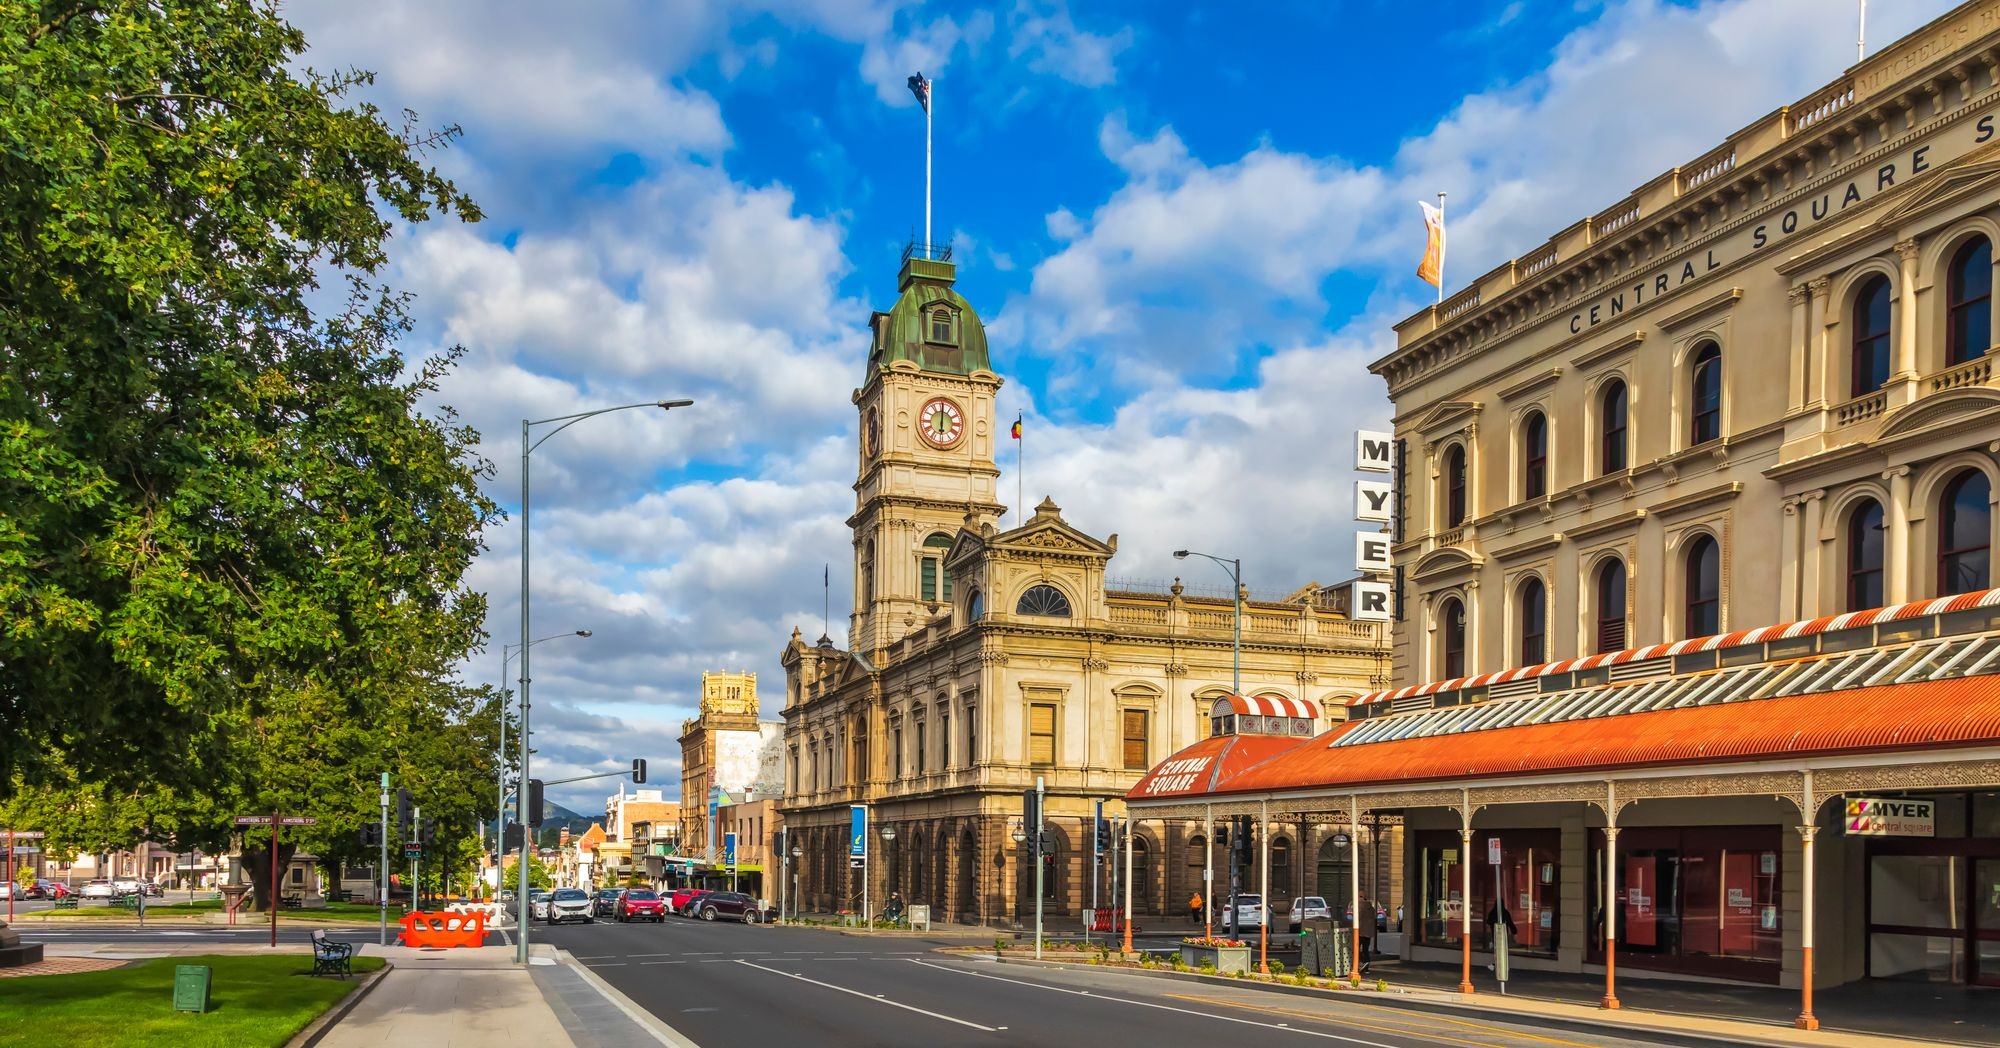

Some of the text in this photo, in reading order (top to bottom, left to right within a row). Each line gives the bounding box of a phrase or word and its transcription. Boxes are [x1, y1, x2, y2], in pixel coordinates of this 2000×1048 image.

[1569, 115, 1994, 334] CENTRAL SQUARE S
[1362, 439, 1389, 612] MYER
[1157, 756, 1213, 776] CENTRAL
[1145, 773, 1199, 796] SQUARE
[1873, 802, 1930, 818] MYER
[1904, 823, 1932, 834] square
